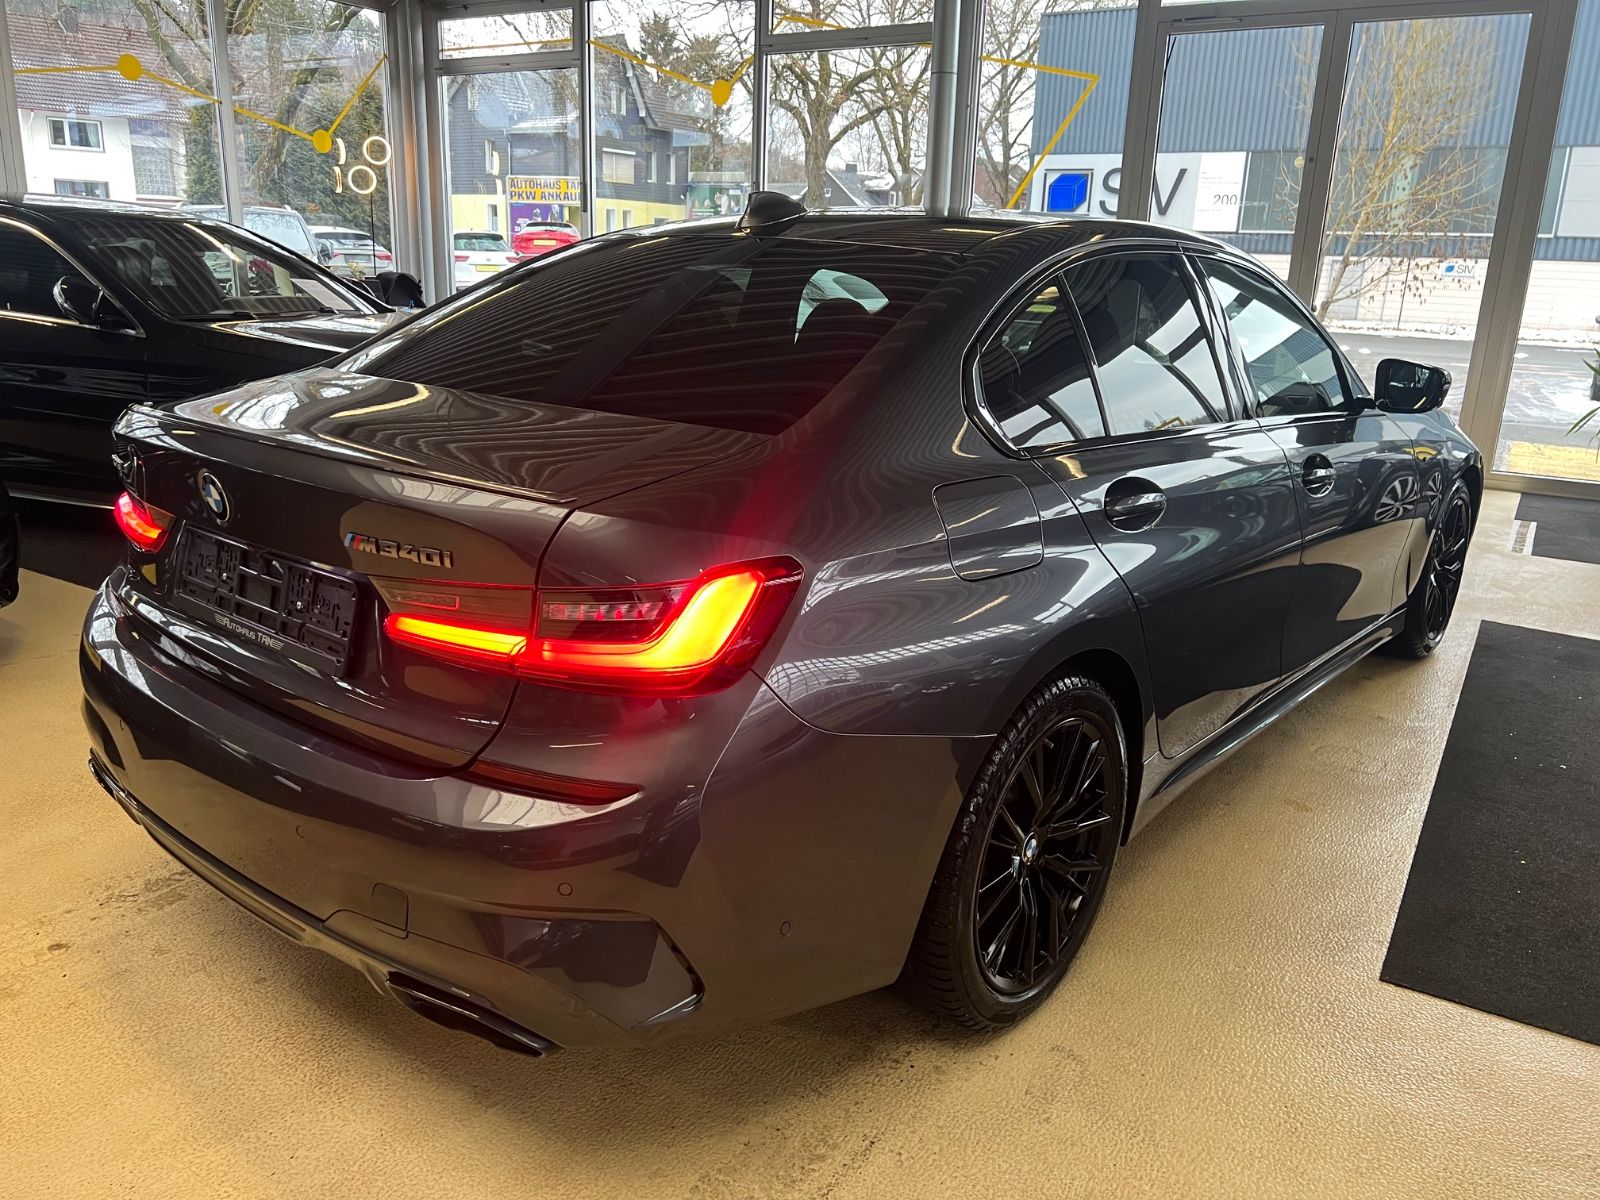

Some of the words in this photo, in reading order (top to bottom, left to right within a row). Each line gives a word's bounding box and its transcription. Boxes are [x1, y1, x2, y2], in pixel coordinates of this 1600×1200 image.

[510, 178, 561, 190] AUTOHAUS
[510, 190, 537, 201] PKW
[540, 191, 580, 201] ANKAU
[1456, 264, 1475, 274] SIV
[350, 533, 453, 569] M340i
